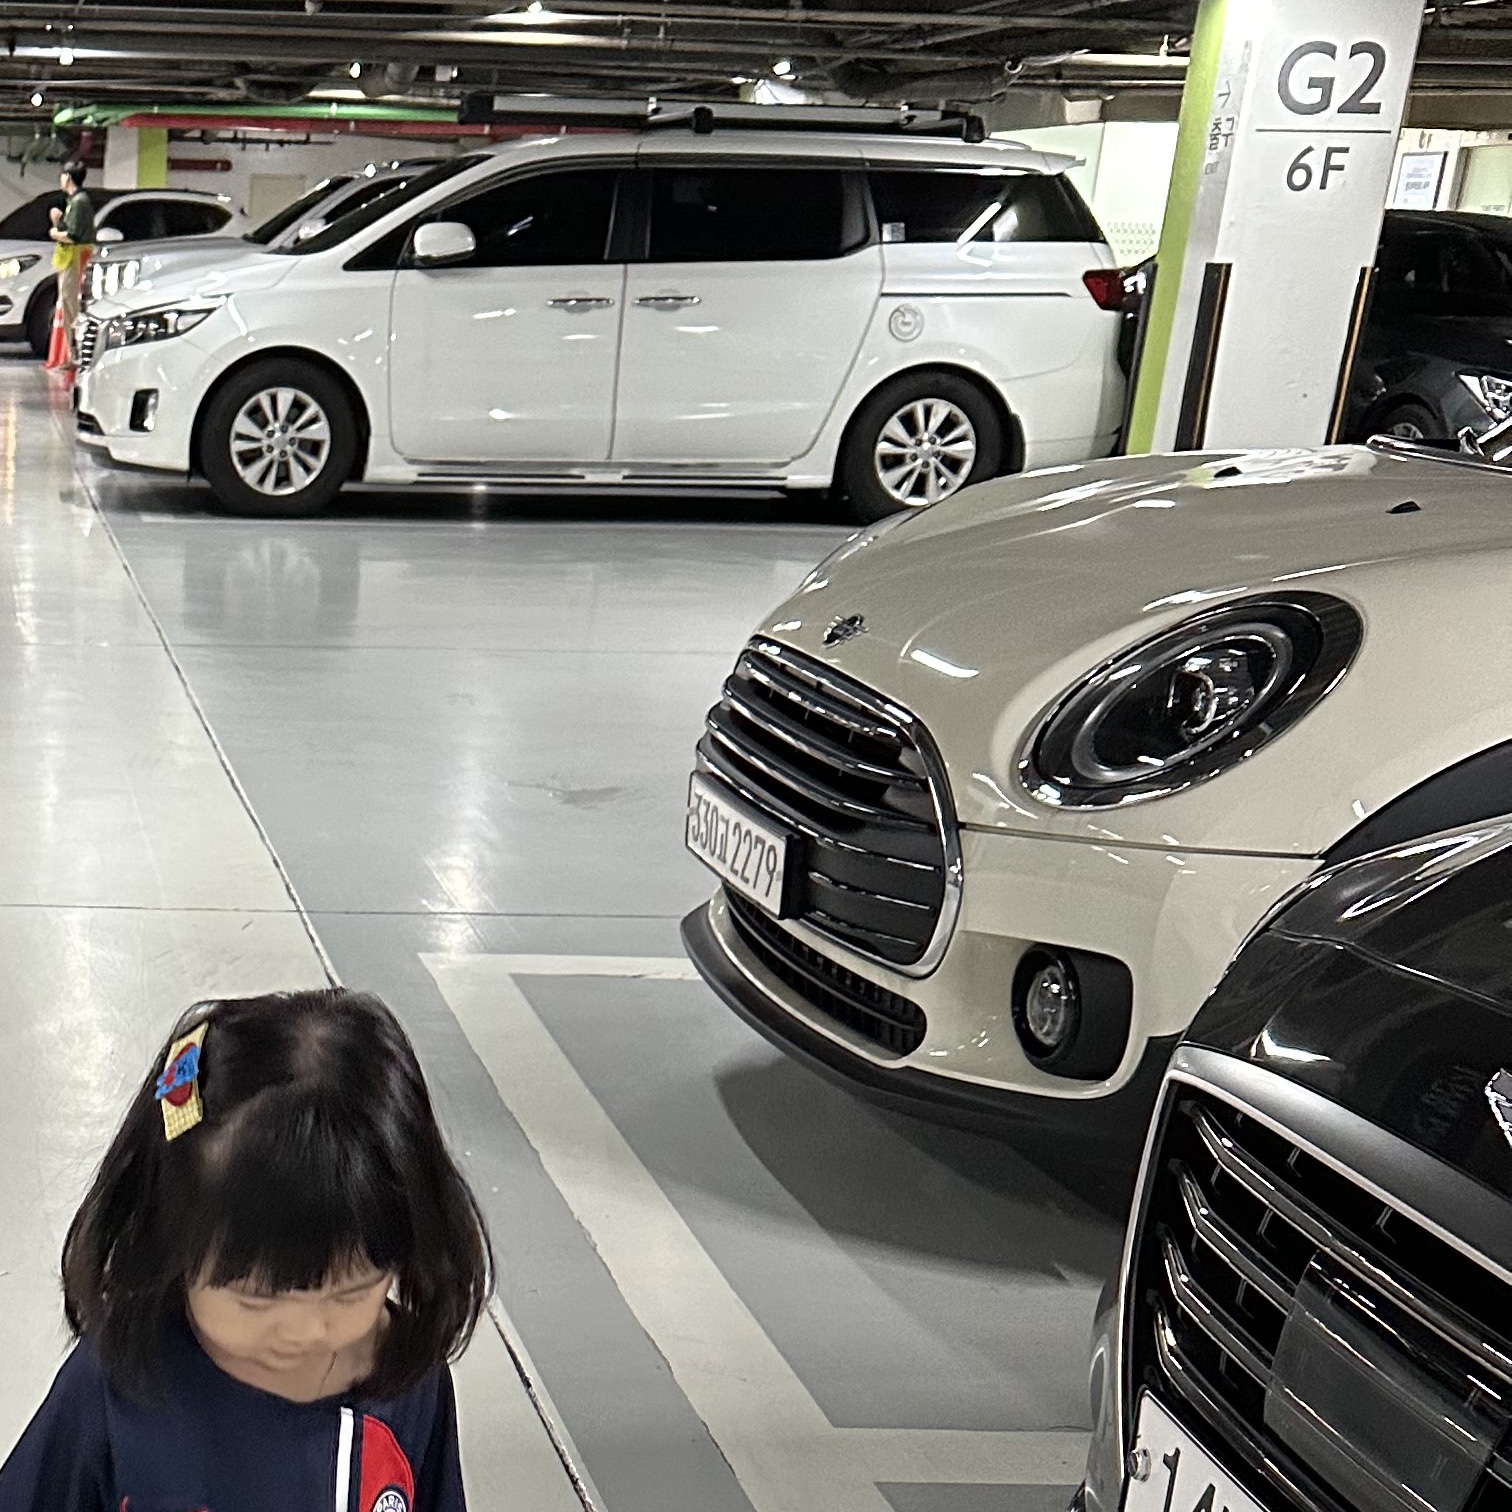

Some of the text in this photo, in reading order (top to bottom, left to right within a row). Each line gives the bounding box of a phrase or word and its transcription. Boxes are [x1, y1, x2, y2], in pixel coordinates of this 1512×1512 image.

[1278, 41, 1386, 115] G2
[1209, 116, 1235, 151] 출구
[1286, 145, 1350, 192] 6F
[730, 821, 778, 898] 2279
